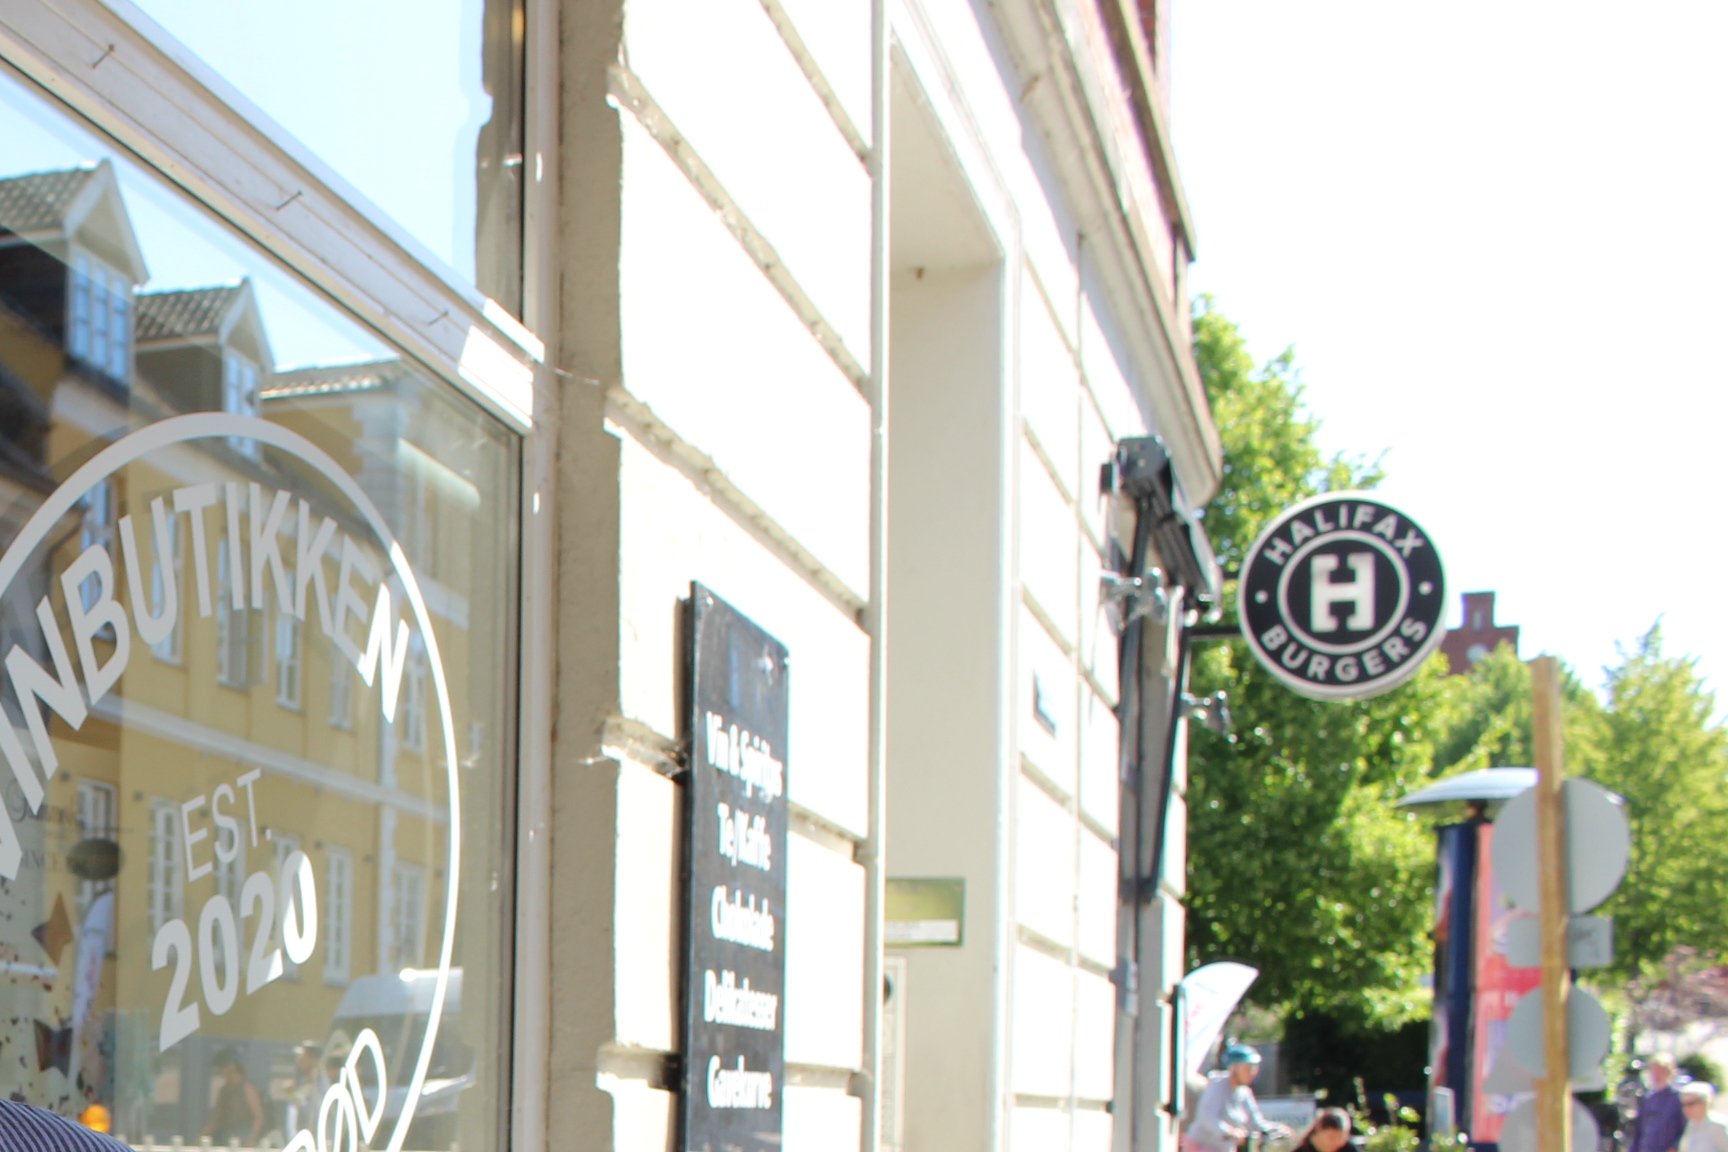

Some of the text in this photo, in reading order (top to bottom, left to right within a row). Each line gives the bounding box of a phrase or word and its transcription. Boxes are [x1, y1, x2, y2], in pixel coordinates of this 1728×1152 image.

[1263, 503, 1424, 566] HALIFAX
[1310, 552, 1375, 633] H
[1261, 617, 1428, 682] BURGERS
[180, 769, 273, 882] EST.
[151, 851, 318, 1051] 2020
[711, 885, 774, 952] Chokolade
